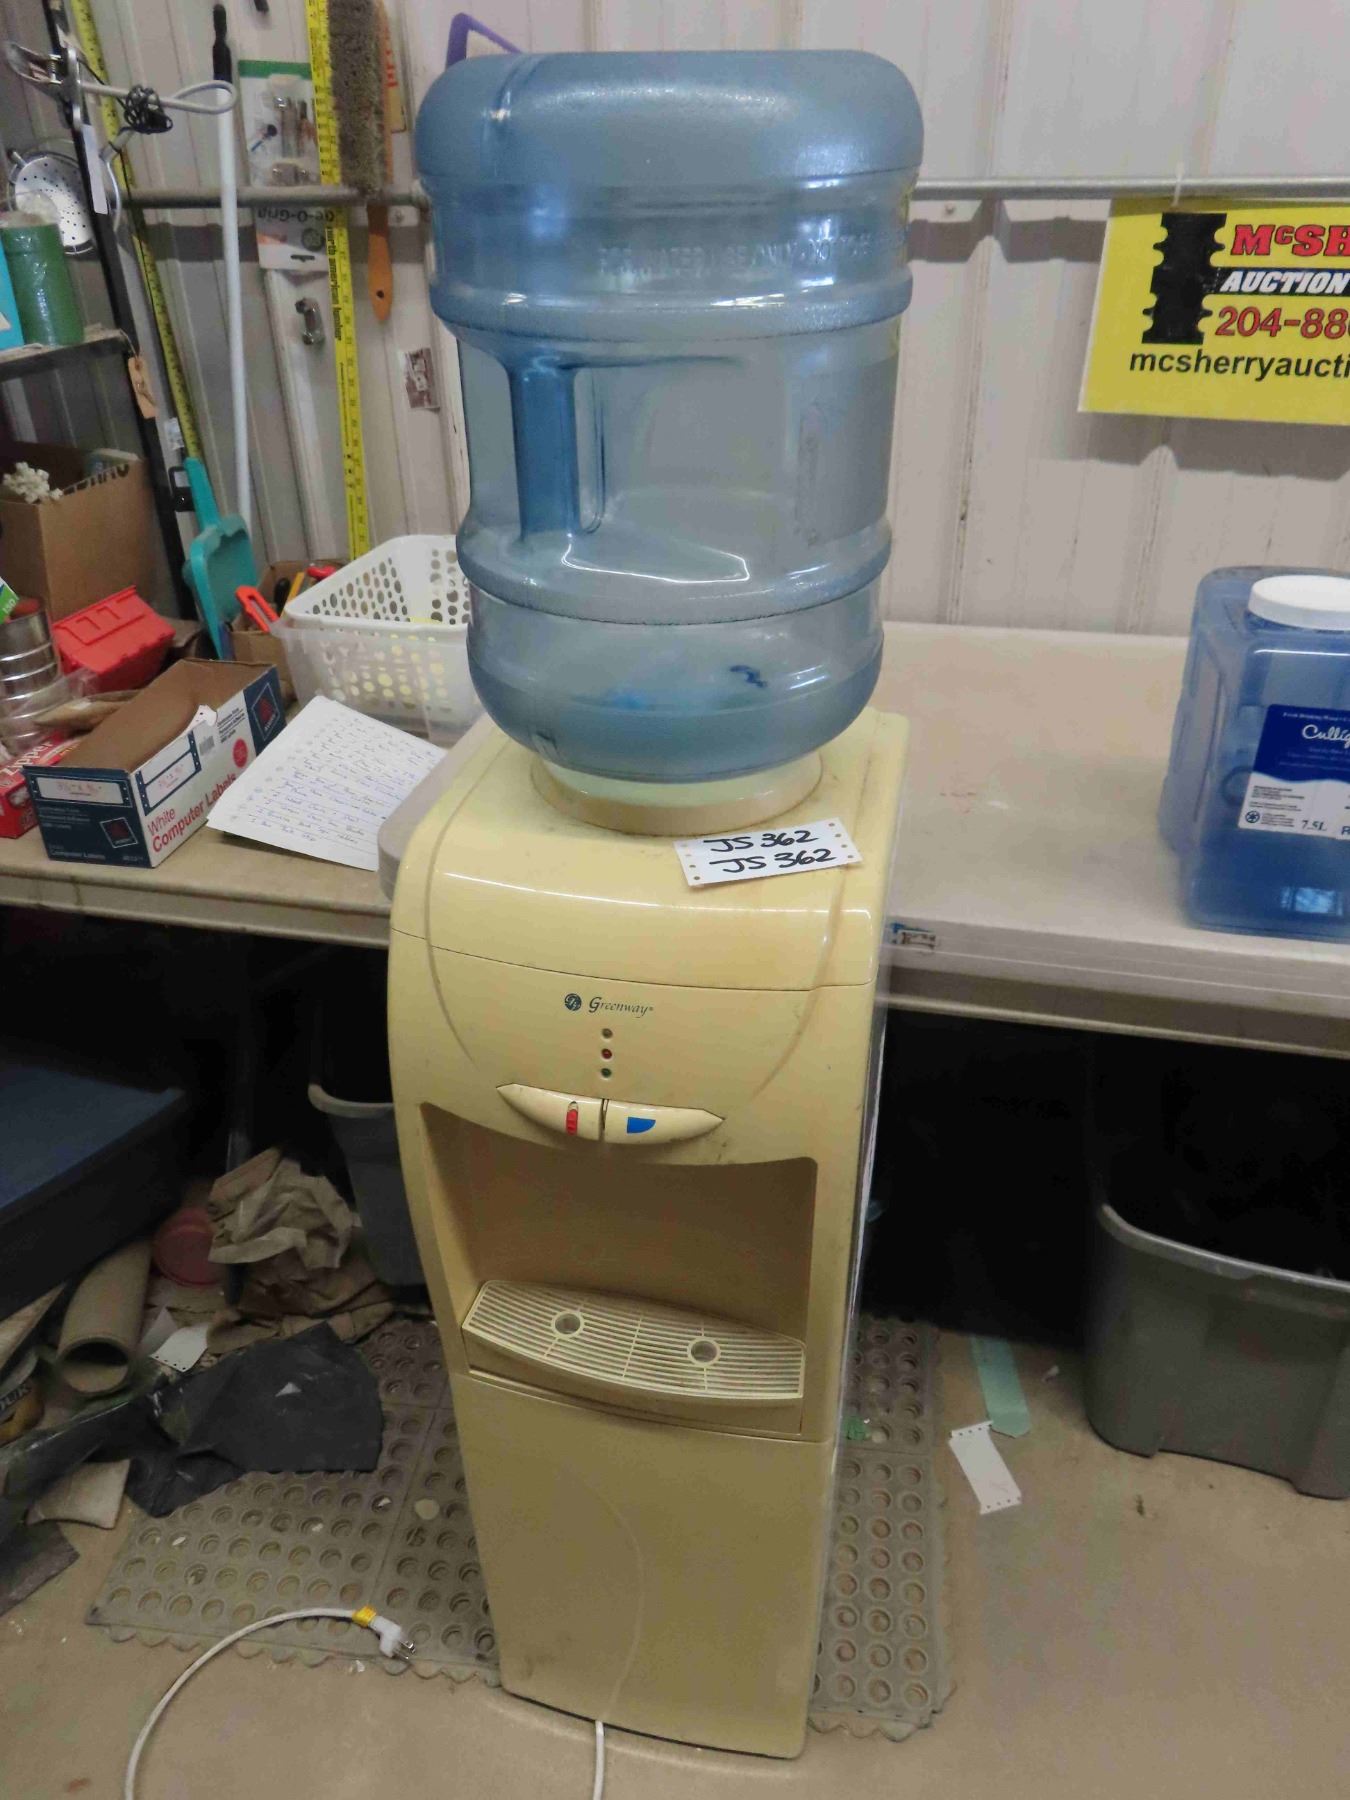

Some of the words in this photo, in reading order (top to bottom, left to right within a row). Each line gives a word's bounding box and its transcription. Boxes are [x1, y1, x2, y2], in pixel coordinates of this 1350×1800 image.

[1215, 306, 1350, 339] 204-88
[147, 808, 176, 836] White
[152, 801, 205, 853] Computer
[703, 836, 754, 853] JS
[760, 829, 819, 848] 362
[709, 855, 767, 873] JS
[774, 848, 837, 869] 362
